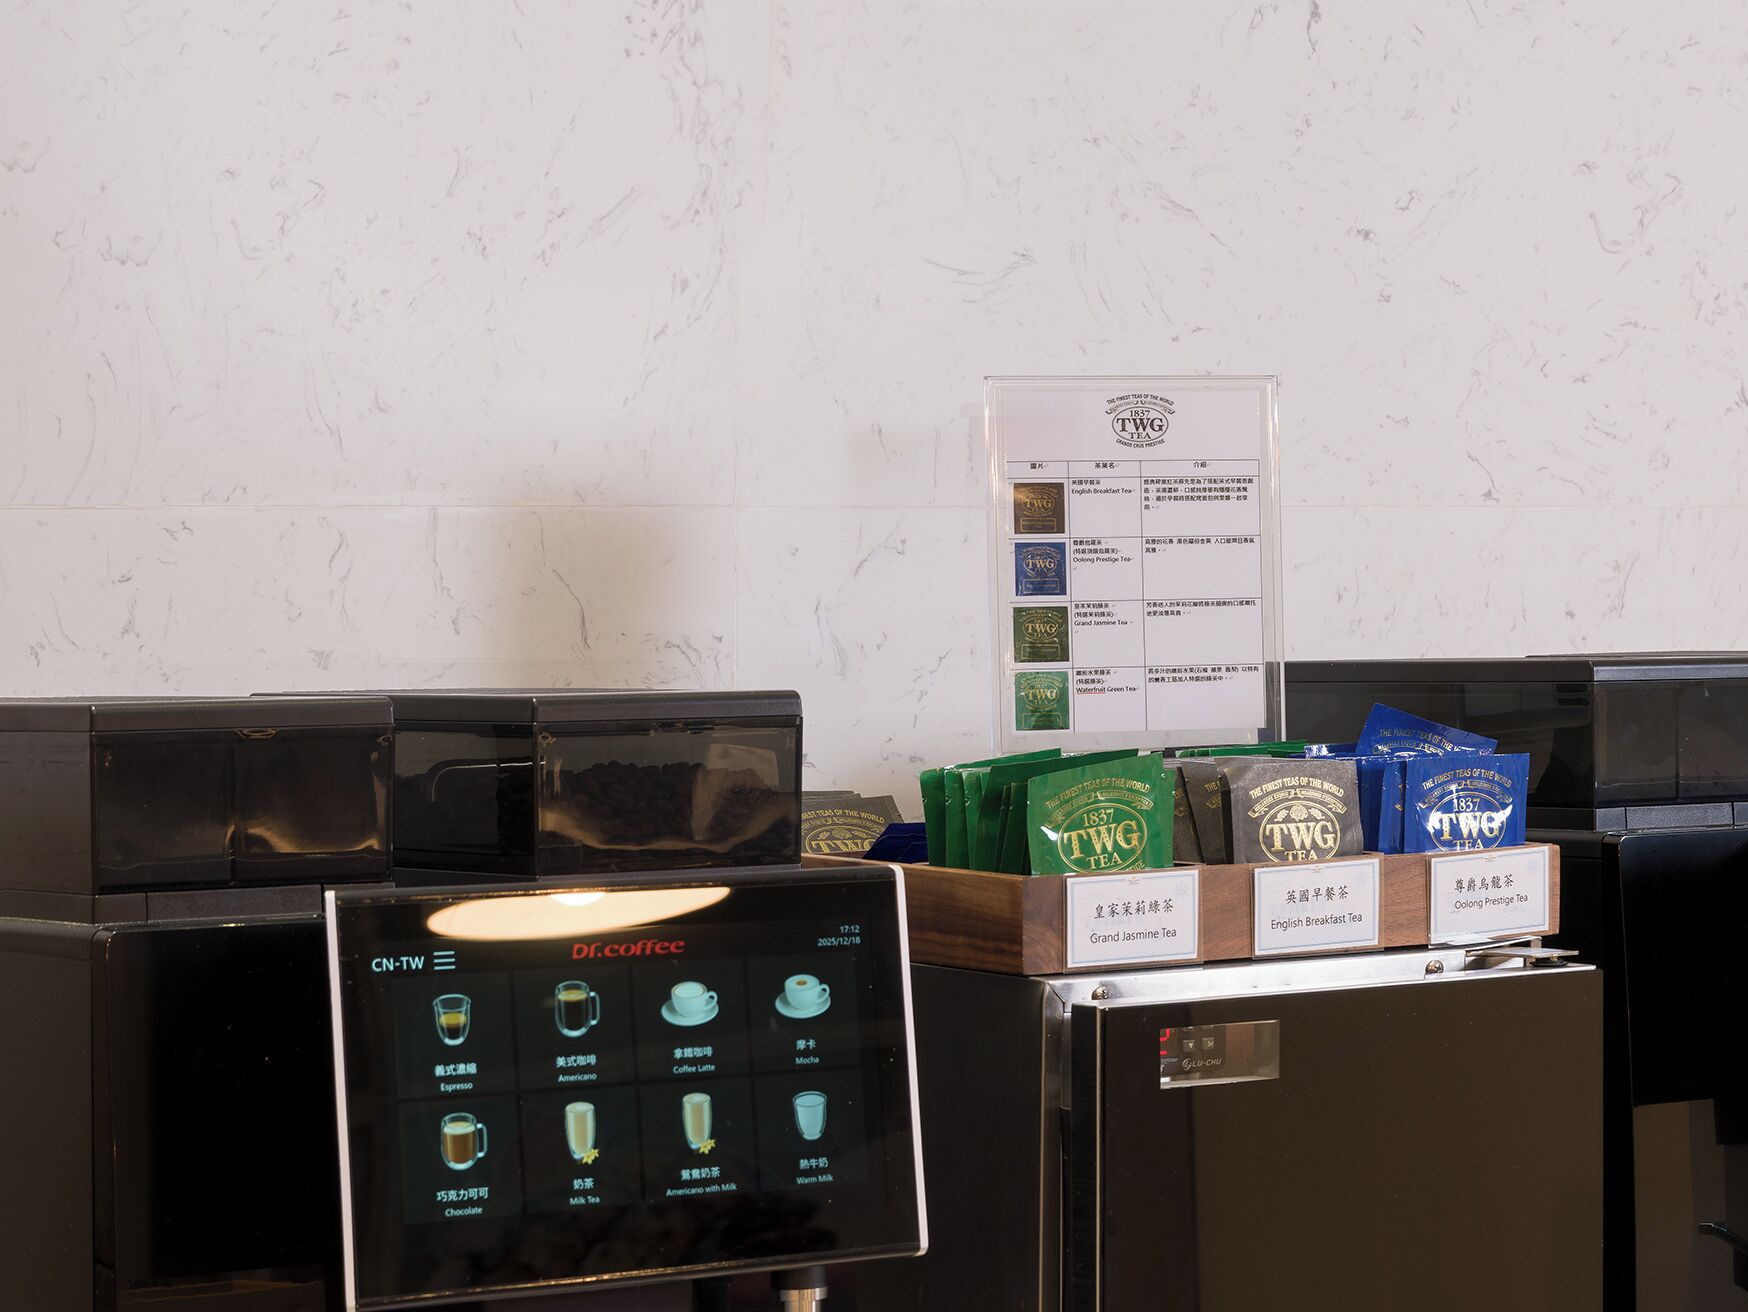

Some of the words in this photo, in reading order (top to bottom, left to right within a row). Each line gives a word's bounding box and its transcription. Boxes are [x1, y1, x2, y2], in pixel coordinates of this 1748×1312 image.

[1116, 418, 1164, 432] TWG
[1025, 623, 1057, 633] TWG
[1026, 689, 1057, 700] TWG
[1432, 734, 1441, 743] OF
[1422, 780, 1434, 790] THE
[1434, 771, 1455, 784] FINEST
[1456, 768, 1471, 778] TEAS
[1472, 768, 1480, 776] OF
[1481, 769, 1494, 780] THE
[1494, 772, 1512, 788] WORLD
[1046, 798, 1060, 809] THE
[1060, 784, 1082, 801] FINEST
[1083, 780, 1100, 790] TEAS
[1101, 778, 1111, 787] OF
[1112, 778, 1125, 787] THE
[1126, 780, 1151, 793] WORLD
[1249, 787, 1261, 798] THE
[1261, 780, 1283, 793] FINEST
[1284, 777, 1299, 787] TEAS
[1300, 776, 1309, 785] OF
[1310, 779, 1322, 788] THE
[1322, 781, 1344, 798] WORLD
[1453, 797, 1480, 812] 1837
[860, 811, 885, 824] WORLD
[1082, 808, 1114, 826] 1837
[1438, 811, 1500, 840] TWG
[1063, 820, 1141, 859] TWG
[1266, 820, 1336, 850] TWG
[1452, 840, 1484, 850] TEA
[1086, 852, 1123, 869] TEA
[1284, 850, 1318, 860] TEA
[1454, 873, 1514, 893] 尊爵烏龍茶
[1286, 884, 1349, 904] 英國早餐茶
[1094, 898, 1174, 919] 皇家茉莉綠茶
[1454, 899, 1483, 910] Oolong
[1485, 896, 1514, 906] Prestige
[1516, 894, 1528, 902] Tea
[1271, 919, 1304, 932] English
[1306, 914, 1346, 927] Breakfast
[1348, 912, 1363, 923] Tea
[840, 925, 860, 934] 17:12
[1090, 931, 1120, 944] Grand
[1122, 929, 1159, 942] Jasmine
[1162, 928, 1177, 938] Tea
[817, 937, 861, 946] 2025/12/18
[572, 939, 686, 960] Dr.coffee
[371, 956, 425, 972] CN-TW
[796, 1039, 816, 1050] 摩卡
[556, 1054, 597, 1068] 美式咖啡
[796, 1056, 819, 1065] Mocha
[673, 1064, 696, 1074] Coffee
[698, 1063, 716, 1072] Latte
[558, 1073, 597, 1083] Americano
[440, 1081, 473, 1092] Espresso
[799, 1157, 828, 1170] 熱牛奶
[680, 1166, 721, 1181] 鴛鴦奶茶
[796, 1175, 818, 1185] Warm
[819, 1173, 833, 1182] Milk
[572, 1177, 594, 1190] 奶茶
[666, 1187, 704, 1197] Americano
[705, 1185, 721, 1193] with
[721, 1183, 737, 1191] Milk
[436, 1186, 489, 1202] 巧克力可可
[570, 1197, 586, 1205] Milk
[445, 1206, 483, 1217] Chocolate
